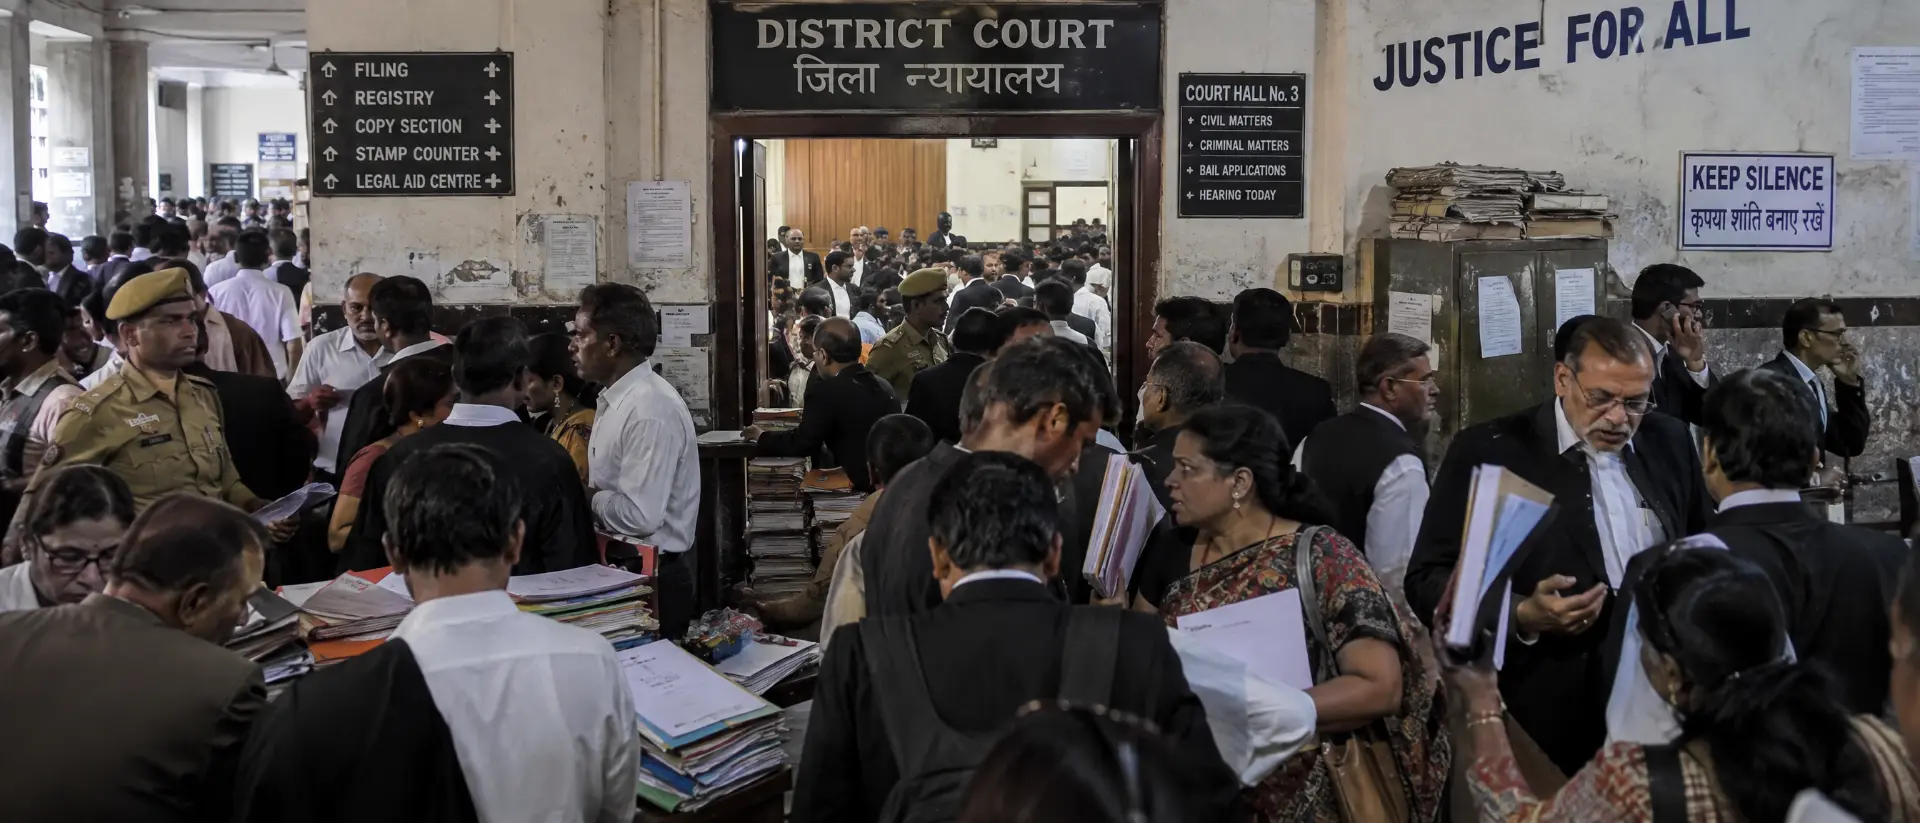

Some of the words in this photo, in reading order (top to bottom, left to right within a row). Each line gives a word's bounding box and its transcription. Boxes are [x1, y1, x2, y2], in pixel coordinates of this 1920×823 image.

[756, 18, 952, 49] DISTRICT
[973, 18, 1114, 49] COURT
[1373, 21, 1541, 91] JUSTICE
[1567, 6, 1645, 64] FOR
[1663, 0, 1751, 50] ALL
[355, 62, 409, 78] FILING
[793, 53, 881, 95] जिला
[904, 63, 1065, 95] न्यायालय
[355, 90, 435, 106] REGISTRY
[1185, 84, 1231, 102] COURT
[1233, 85, 1267, 102] HALL
[1269, 85, 1288, 102] No.
[1290, 85, 1299, 102] 3
[355, 118, 396, 134] COPY
[400, 118, 462, 134] SECTION
[1200, 114, 1226, 126] CIVIL
[1228, 115, 1273, 127] MATTERS
[1200, 139, 1244, 151] CRIMINAL
[1247, 139, 1289, 151] MATTERS
[355, 146, 408, 162] STAMP
[413, 146, 480, 162] COUNTER
[1199, 164, 1220, 176] BAIL
[1222, 164, 1287, 177] APPLICATIONS
[1692, 164, 1741, 191] KEEP
[1745, 165, 1824, 191] SILENCE
[356, 173, 400, 189] LEGAL
[403, 173, 426, 189] AID
[430, 173, 482, 189] CENTRE
[1199, 189, 1242, 201] HEARING
[1245, 189, 1277, 201] TODAY
[1690, 208, 1728, 238] कृपया
[1730, 200, 1763, 232] शांति
[1765, 209, 1799, 236] बनाए
[1801, 201, 1825, 232] रखें
